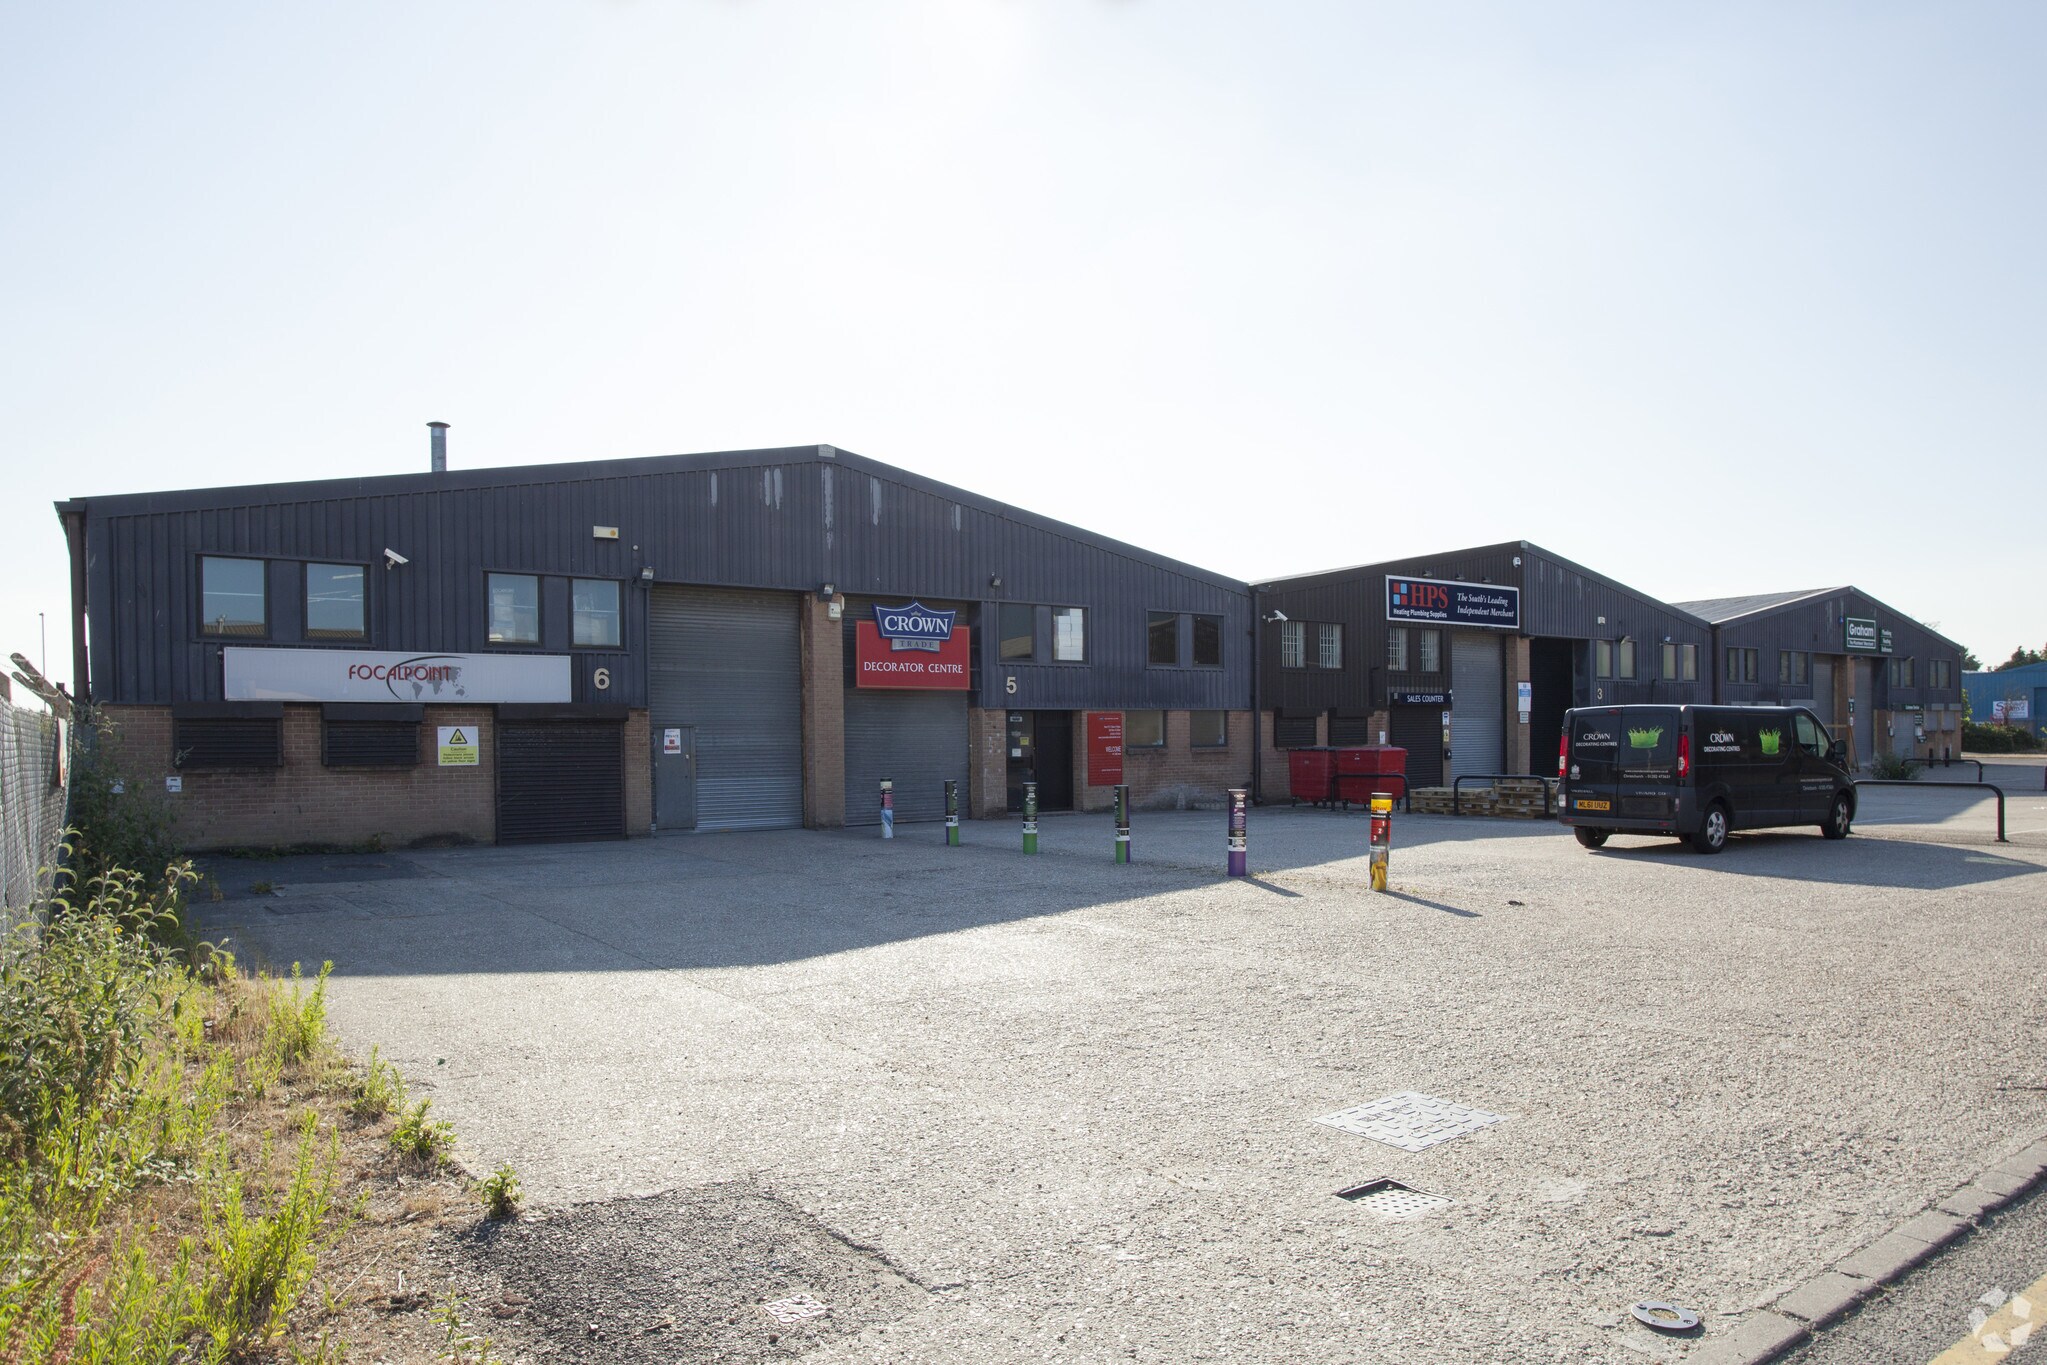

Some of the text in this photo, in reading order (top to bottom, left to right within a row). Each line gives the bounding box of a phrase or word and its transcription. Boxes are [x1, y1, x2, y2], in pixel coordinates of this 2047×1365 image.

[1410, 583, 1449, 609] HPS
[1457, 592, 1509, 607] The South's Leading
[1393, 608, 1410, 617] Heating
[1410, 609, 1430, 618] Plumbing
[1457, 605, 1515, 618] Independent Merchant
[884, 615, 949, 633] CROWN
[1849, 623, 1874, 637] Graham
[899, 640, 935, 648] TRADE
[348, 664, 452, 682] FOCALPOINT
[864, 661, 963, 674] DECORATOR CENTRE
[593, 667, 610, 690] 6
[1006, 676, 1018, 694] 5
[1406, 694, 1444, 703] SALES COUNTER
[1597, 688, 1603, 700] 3
[1582, 733, 1611, 741] CROWN
[1709, 733, 1735, 743] CROWN
